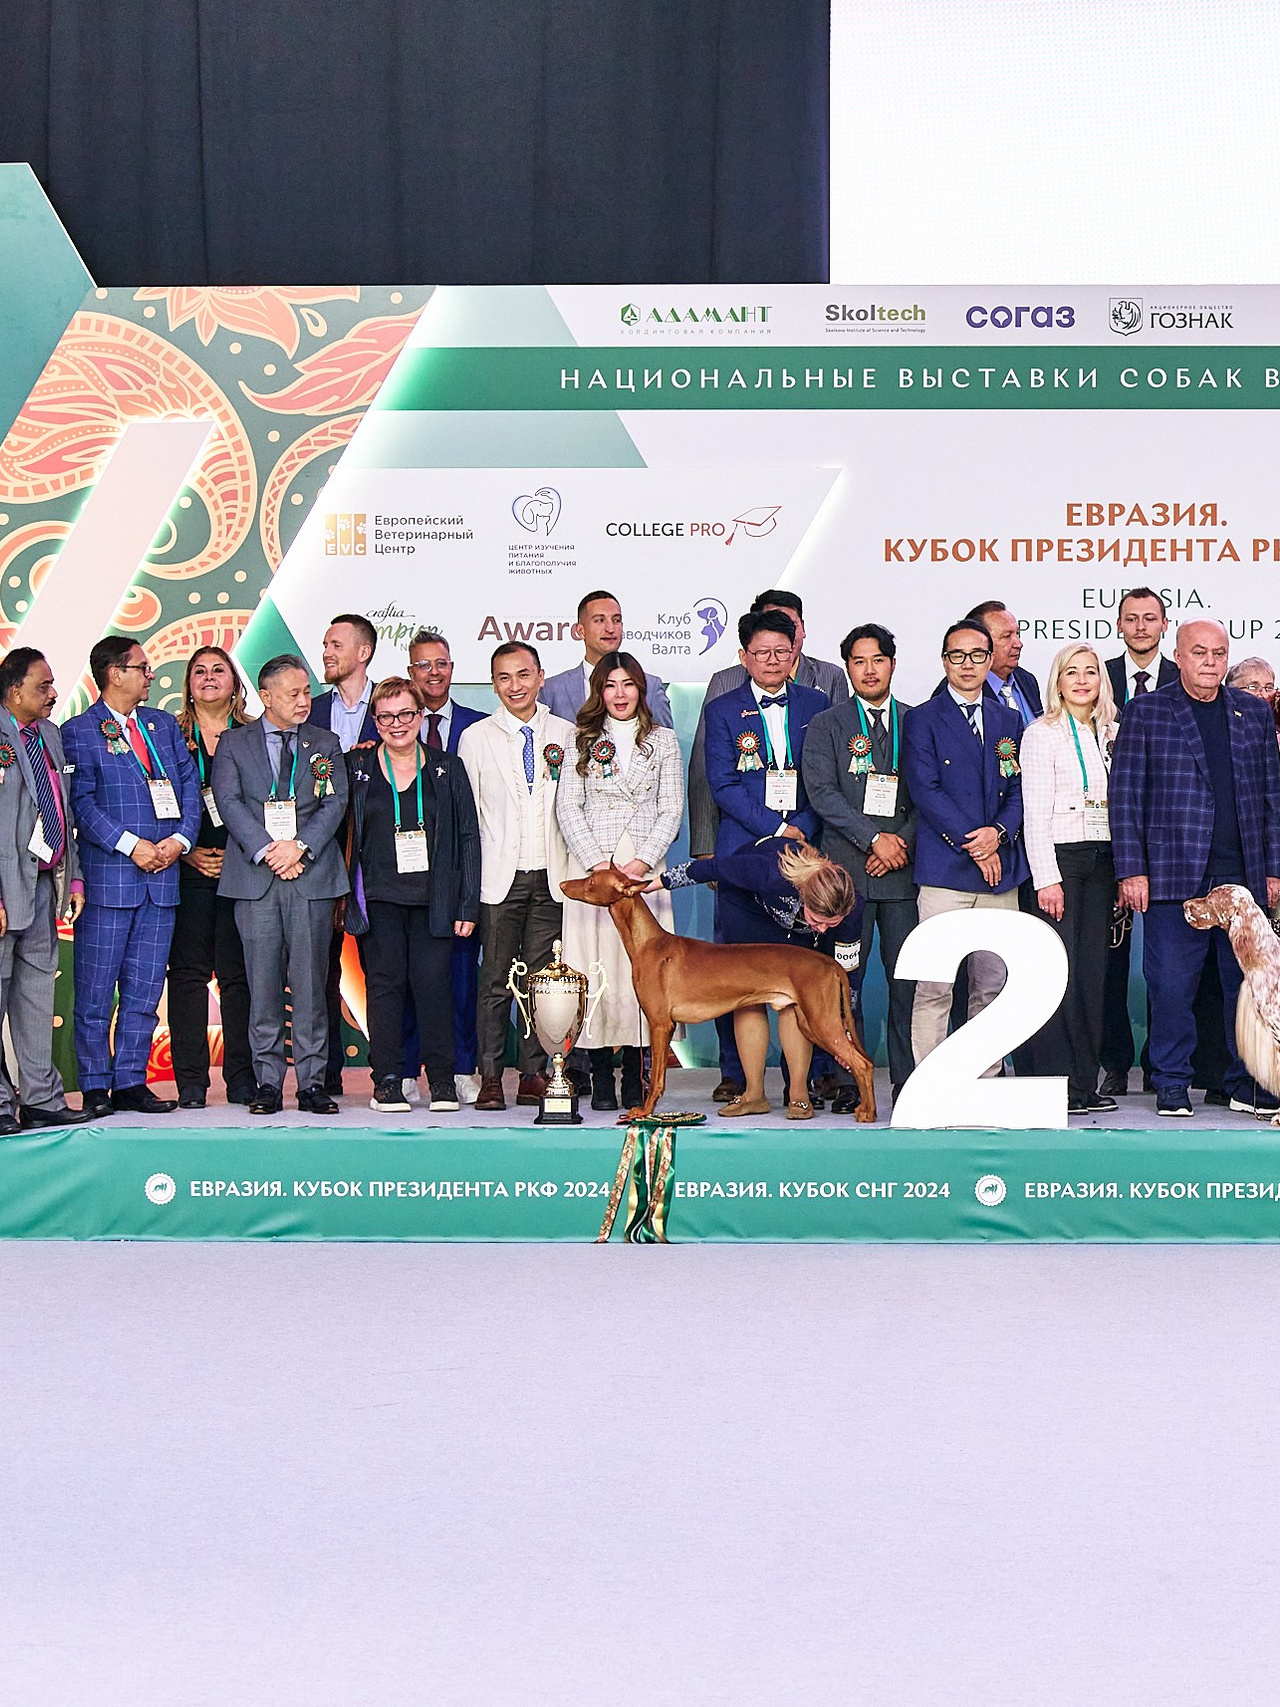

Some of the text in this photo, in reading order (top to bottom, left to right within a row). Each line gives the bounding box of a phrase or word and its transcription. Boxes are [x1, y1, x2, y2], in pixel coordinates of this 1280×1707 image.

[826, 305, 925, 321] Skoltech
[1151, 313, 1233, 328] ГОЗНАК
[619, 328, 704, 336] ХОЛДИНГОВАЯ
[561, 369, 875, 392] НАЦИОНАЛЬНЫЕ
[900, 369, 1097, 387] ВЫСТАВКИ
[1121, 368, 1242, 387] СОБАК
[375, 515, 463, 527] Европейский
[1067, 503, 1227, 526] ЕВРАЗИЯ.
[375, 530, 473, 541] Ветеринарный
[606, 523, 725, 536] COLLEGE PRO
[375, 544, 415, 555] Центр
[885, 539, 999, 562] КУБОК
[1012, 539, 1240, 567] ПРЕЗИДЕНТА
[1083, 588, 1212, 609] EUSIA.
[657, 613, 692, 627] Клуб
[621, 630, 692, 641] водчиков
[652, 643, 691, 655] Валта
[891, 908, 1070, 1129] 2
[191, 1180, 609, 1200] ЕВРАЗИЯ. КУБОК ПРЕЗИДЕНТА РКФ 2024
[675, 1181, 950, 1198] ЕВРАЗИЯ. КУБОК СНГ 2024
[1025, 1182, 1124, 1198] ЕВРАЗИЯ.
[1131, 1182, 1200, 1199] КУБОК
